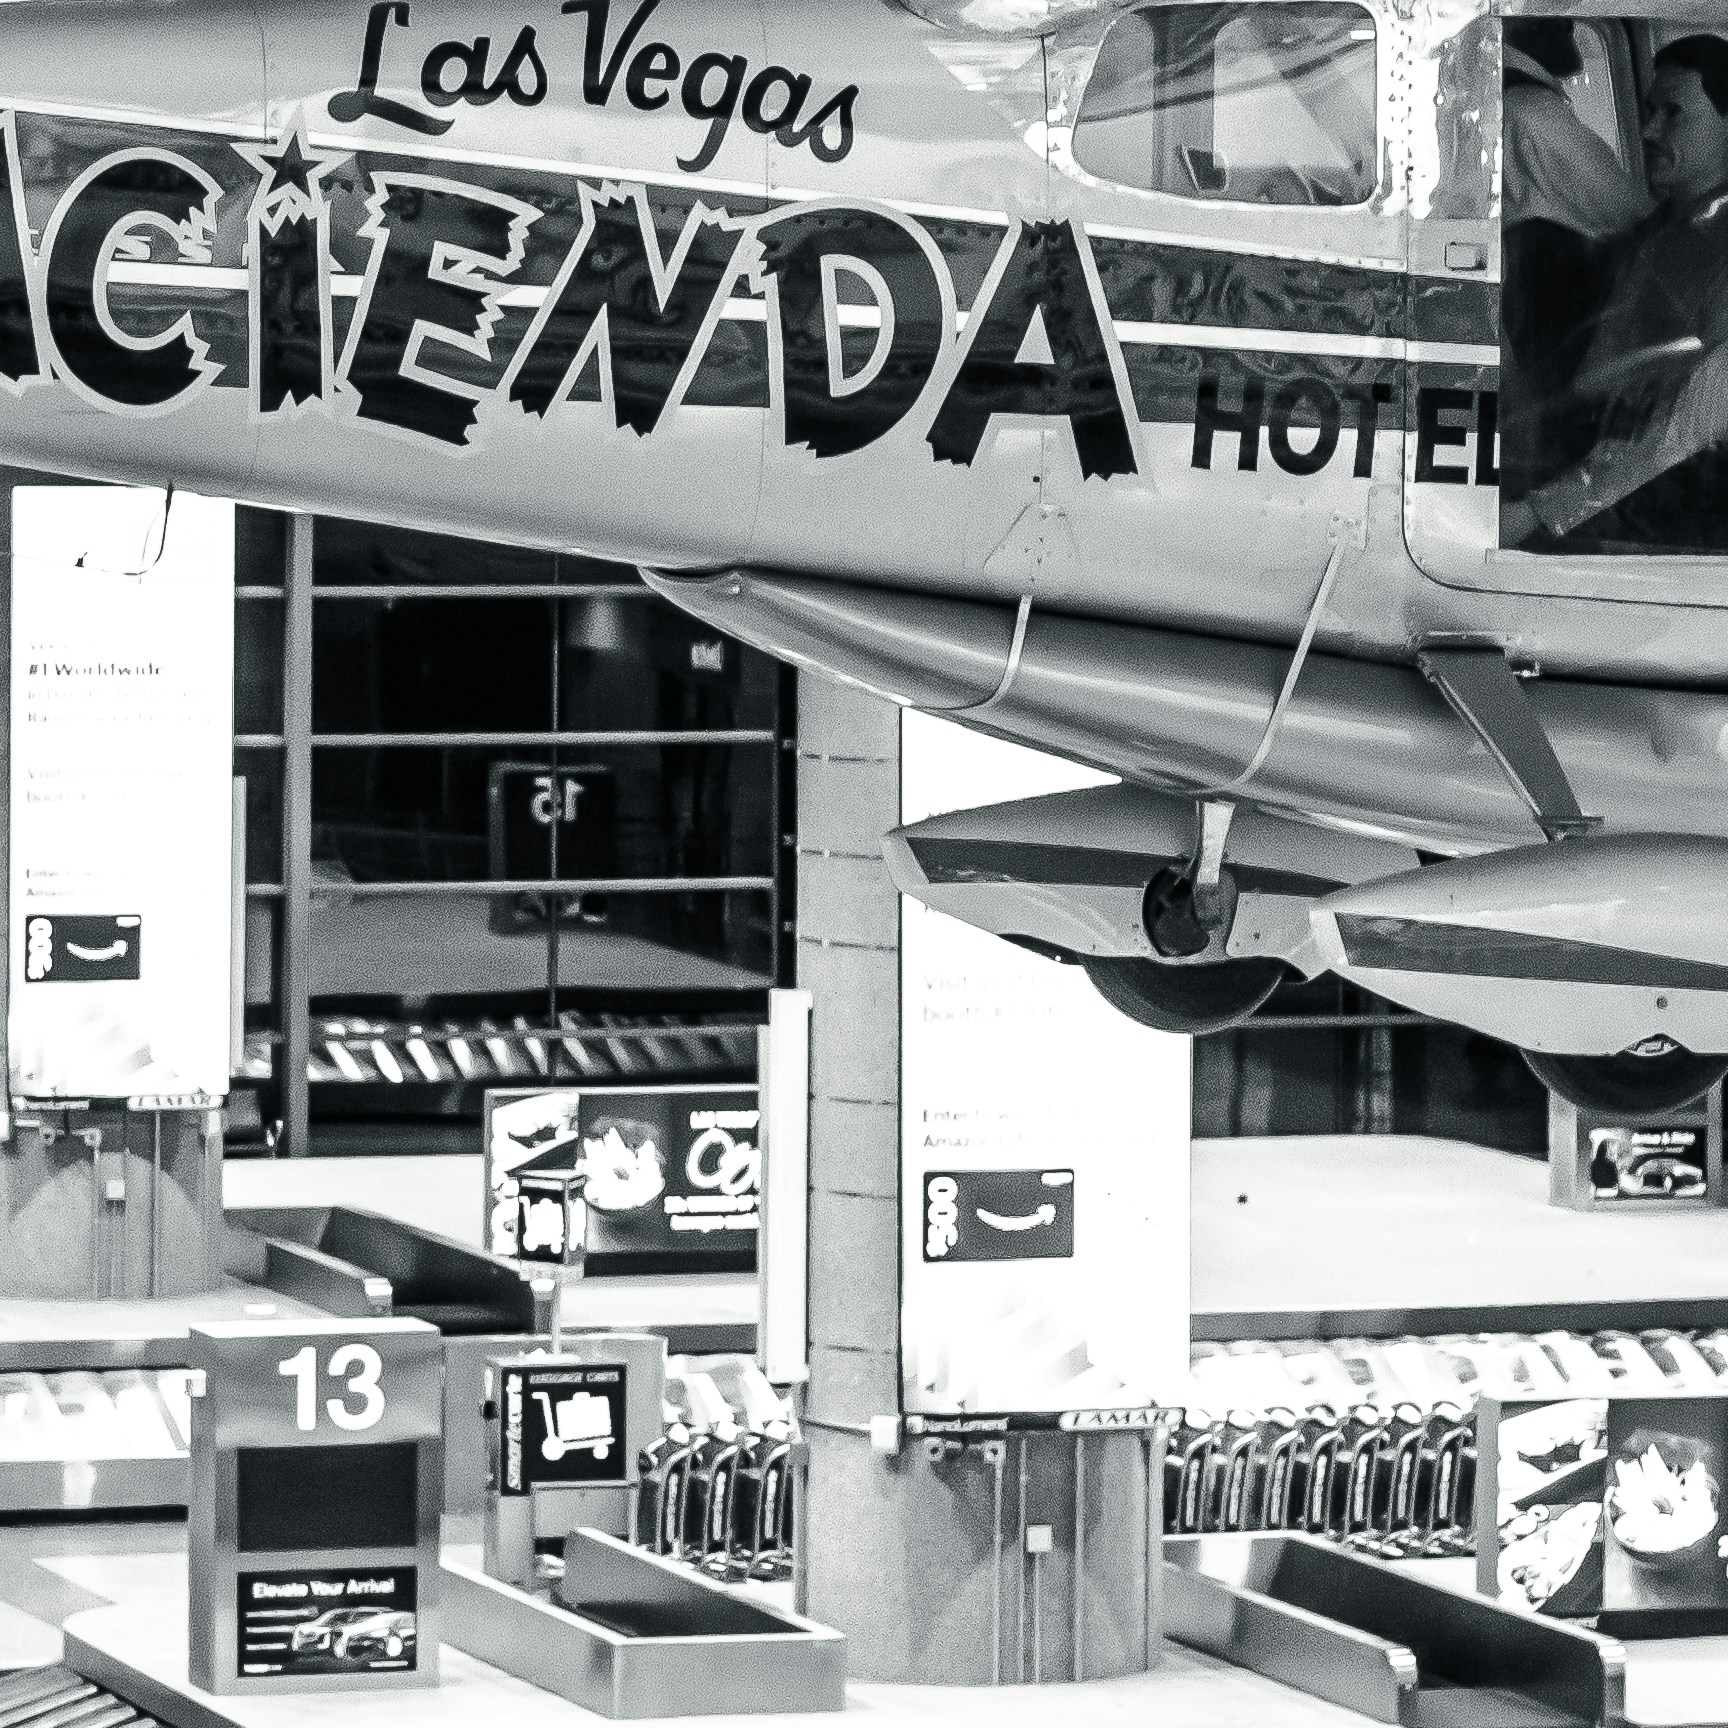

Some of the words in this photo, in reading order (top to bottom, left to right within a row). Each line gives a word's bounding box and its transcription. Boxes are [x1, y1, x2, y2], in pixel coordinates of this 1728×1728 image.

[328, 1, 548, 136] Las
[1190, 375, 1500, 487] HOTEL
[277, 1343, 386, 1432] 13
